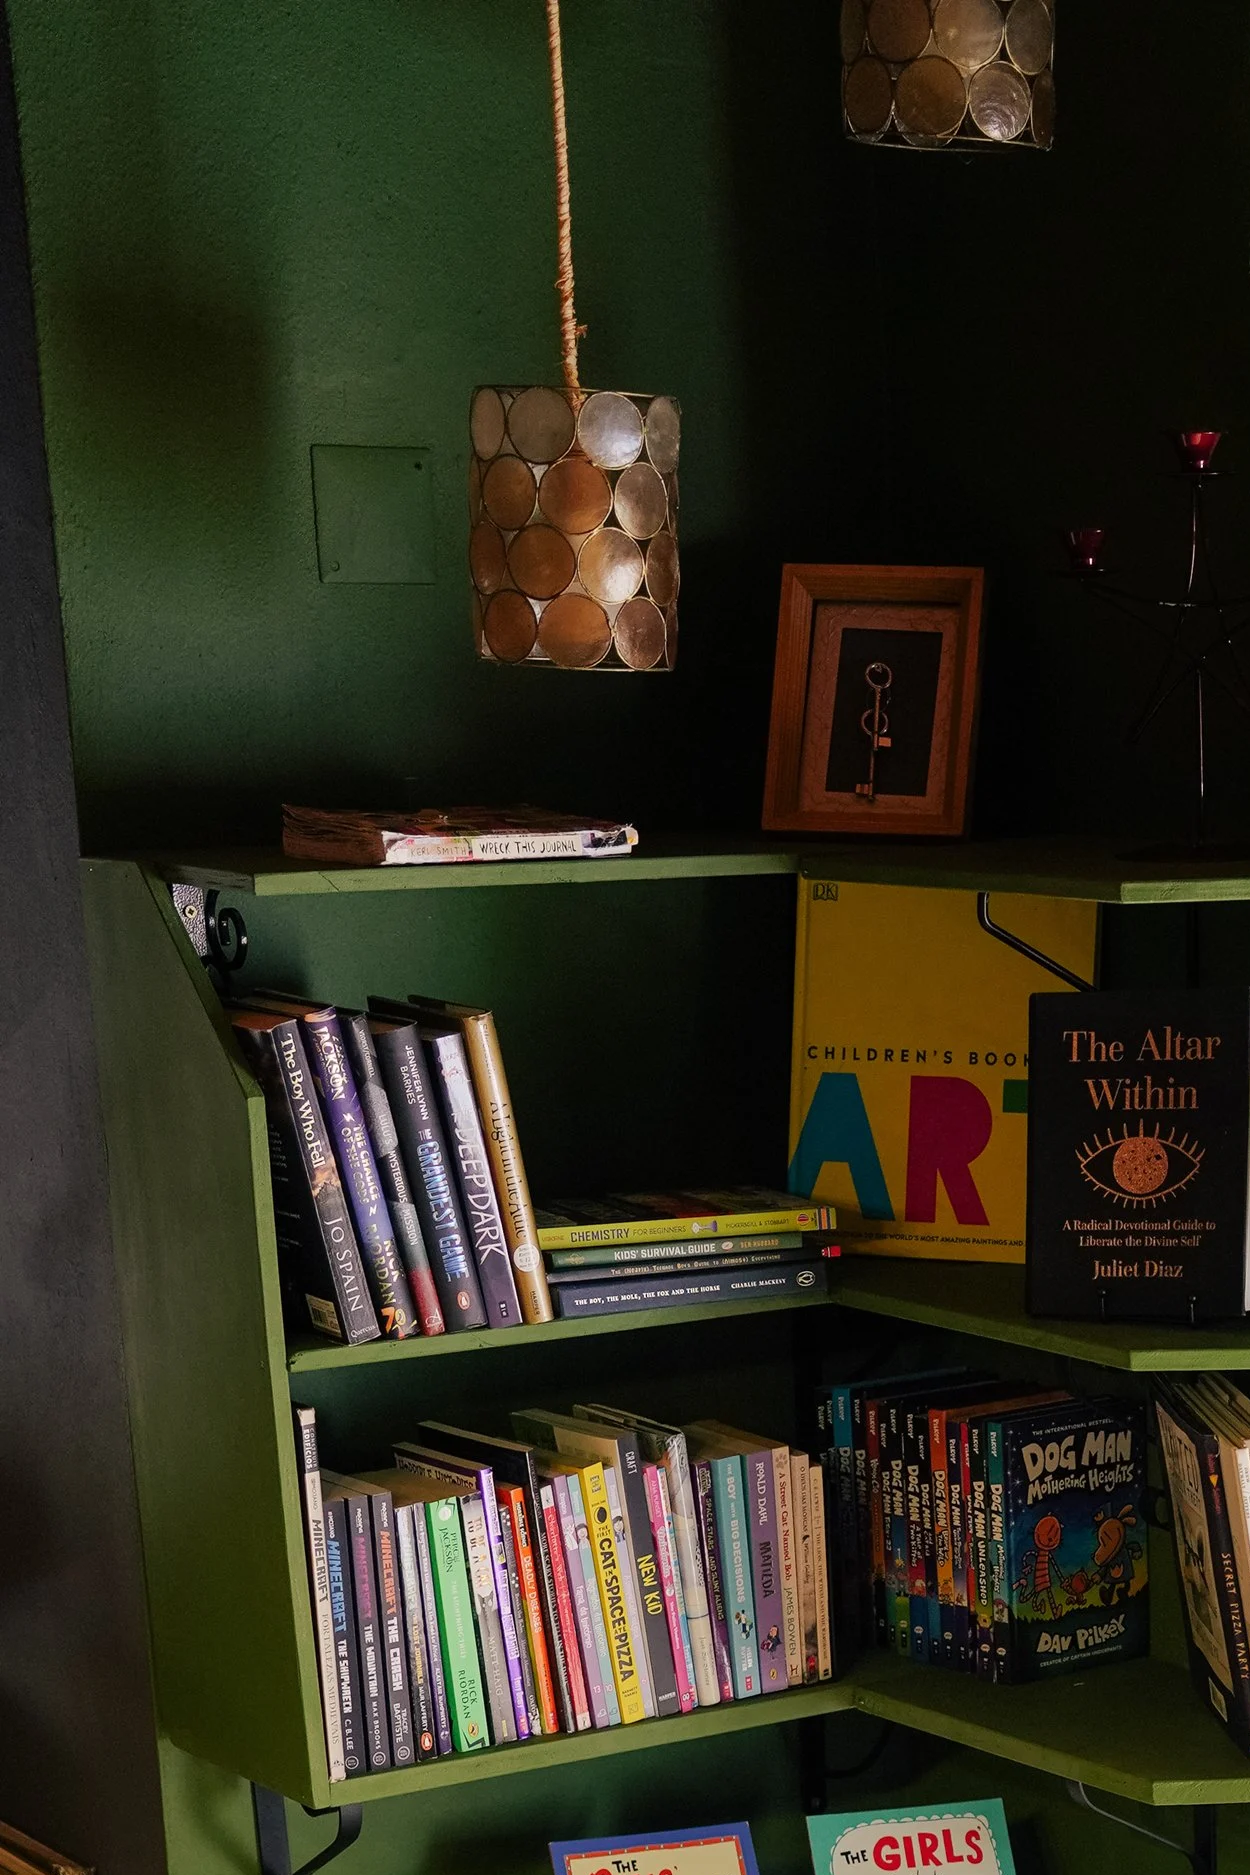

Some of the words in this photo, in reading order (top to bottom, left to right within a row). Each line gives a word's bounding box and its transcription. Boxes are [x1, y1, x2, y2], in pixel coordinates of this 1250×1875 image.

[479, 839, 511, 854] WRECK
[514, 840, 535, 854] THIS
[539, 839, 577, 854] JOURNAL
[1063, 1031, 1124, 1062] The
[1137, 1026, 1220, 1060] Altar
[807, 1045, 953, 1065] CHILDREN'S
[1085, 1078, 1198, 1110] Within
[570, 1229, 630, 1242] CHEMISTRY
[633, 1227, 650, 1238] FOR
[653, 1222, 687, 1236] BEGINNERS
[1063, 1220, 1072, 1230] A
[1073, 1220, 1112, 1231] Radical
[1114, 1219, 1169, 1231] Devotional
[1172, 1219, 1201, 1231] Guide
[1203, 1220, 1216, 1230] to
[641, 1242, 686, 1258] SURVIVAL
[688, 1242, 716, 1254] GUIDE
[1092, 1261, 1139, 1280] Juliet
[1144, 1261, 1183, 1278] Diaz
[730, 1280, 758, 1291] CHARLIE
[759, 1277, 786, 1288] MACKESY
[1021, 1441, 1078, 1481] DOG
[1081, 1430, 1132, 1466] MAN
[637, 1554, 657, 1585] NEW
[645, 1587, 664, 1616] KID
[611, 1860, 639, 1874] THE
[841, 1850, 869, 1865] THE
